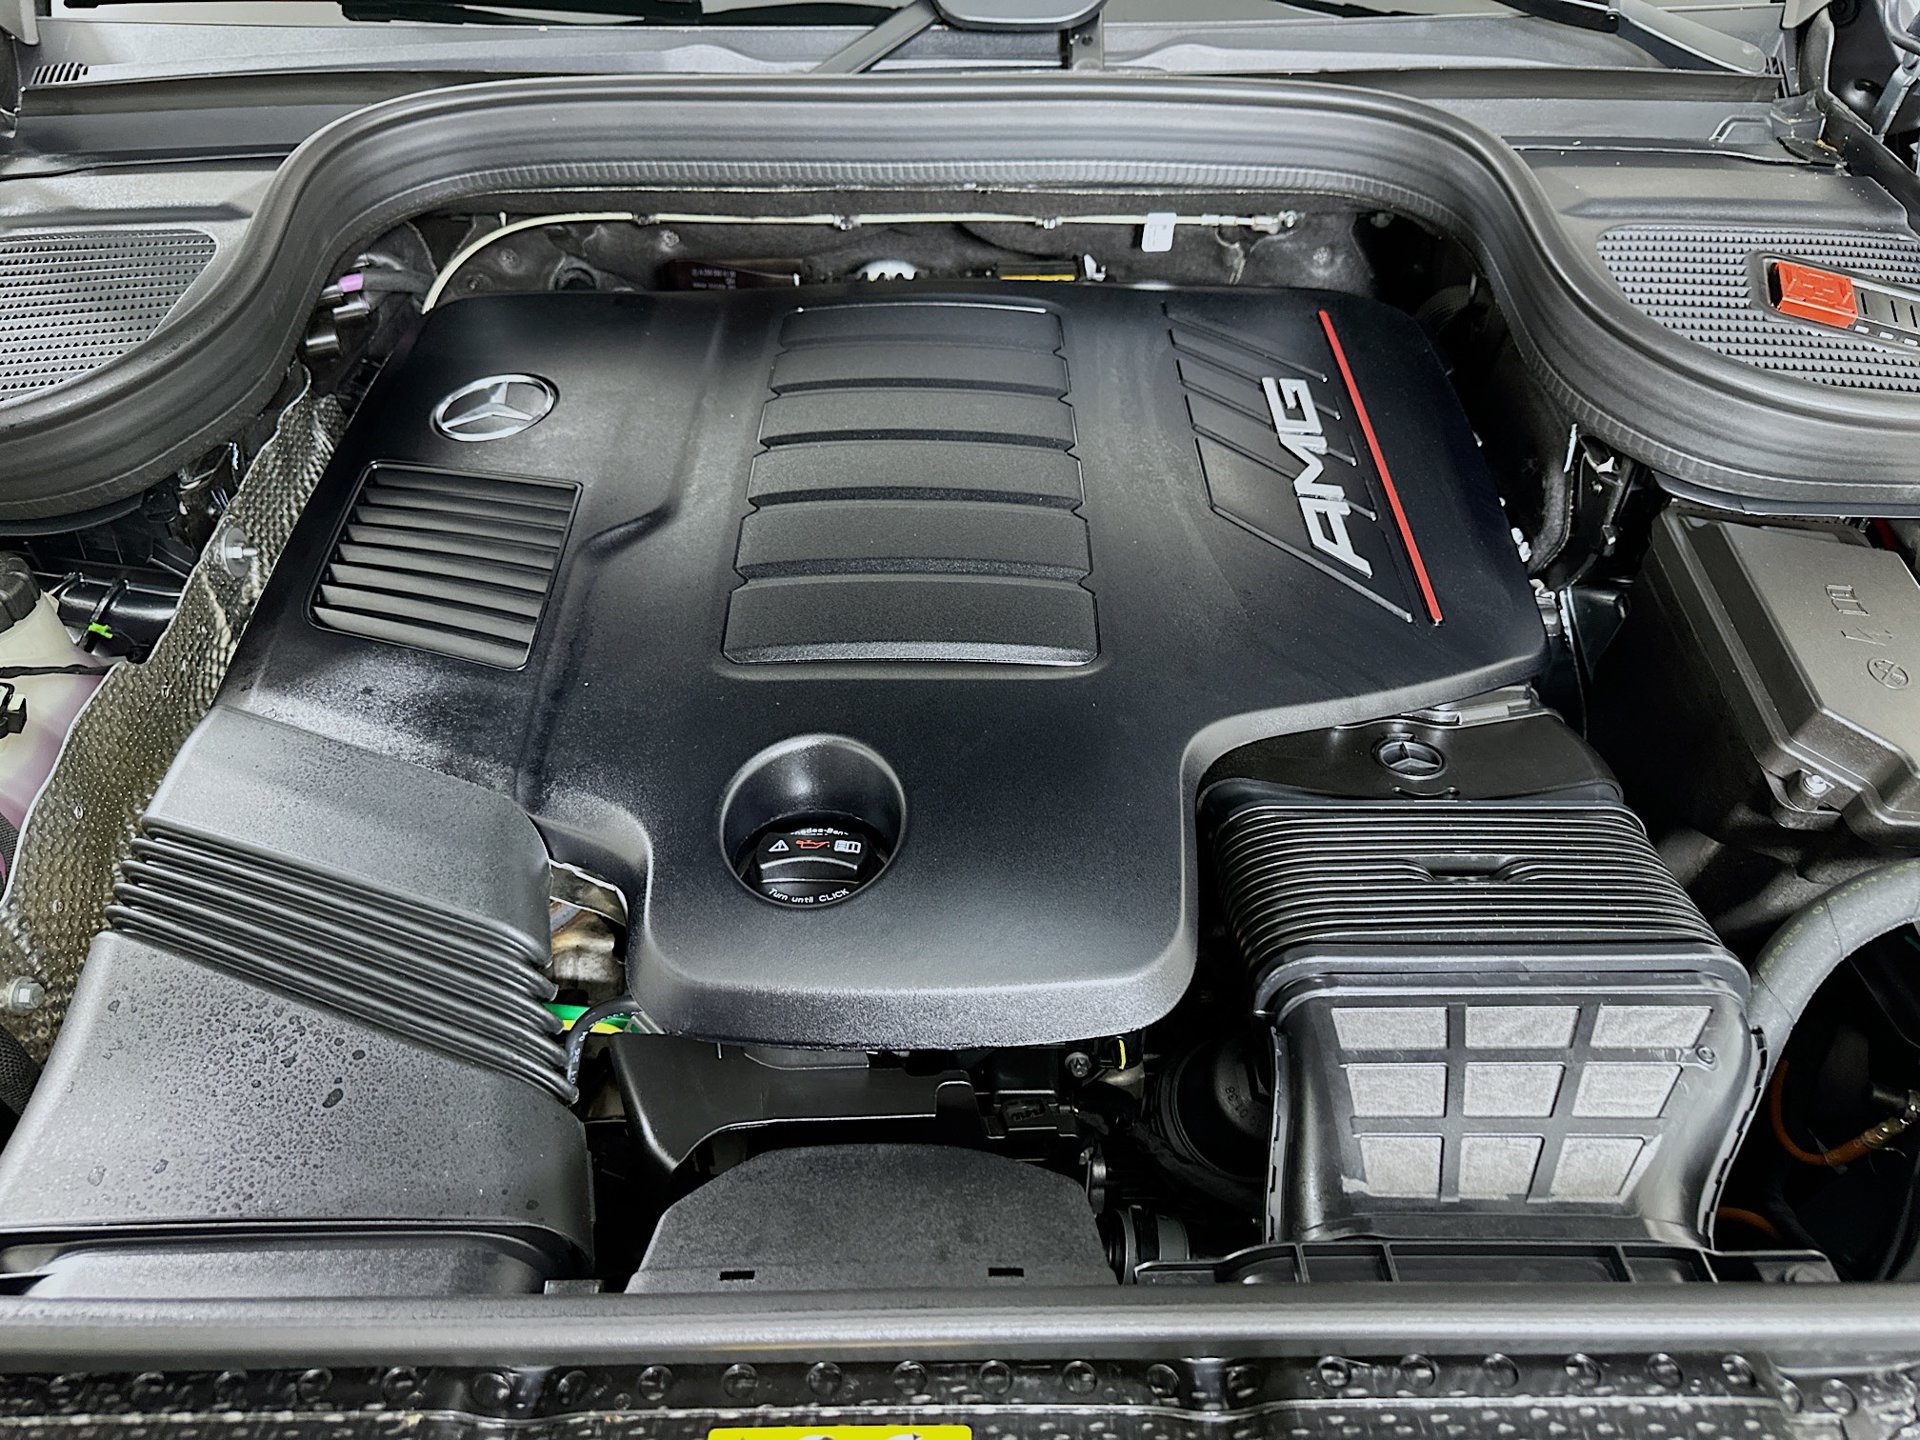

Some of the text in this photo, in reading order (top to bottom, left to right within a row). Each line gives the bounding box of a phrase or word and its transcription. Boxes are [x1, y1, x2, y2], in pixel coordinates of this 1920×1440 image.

[1261, 376, 1373, 579] AMG
[768, 887, 850, 904] Turn until CLICK
